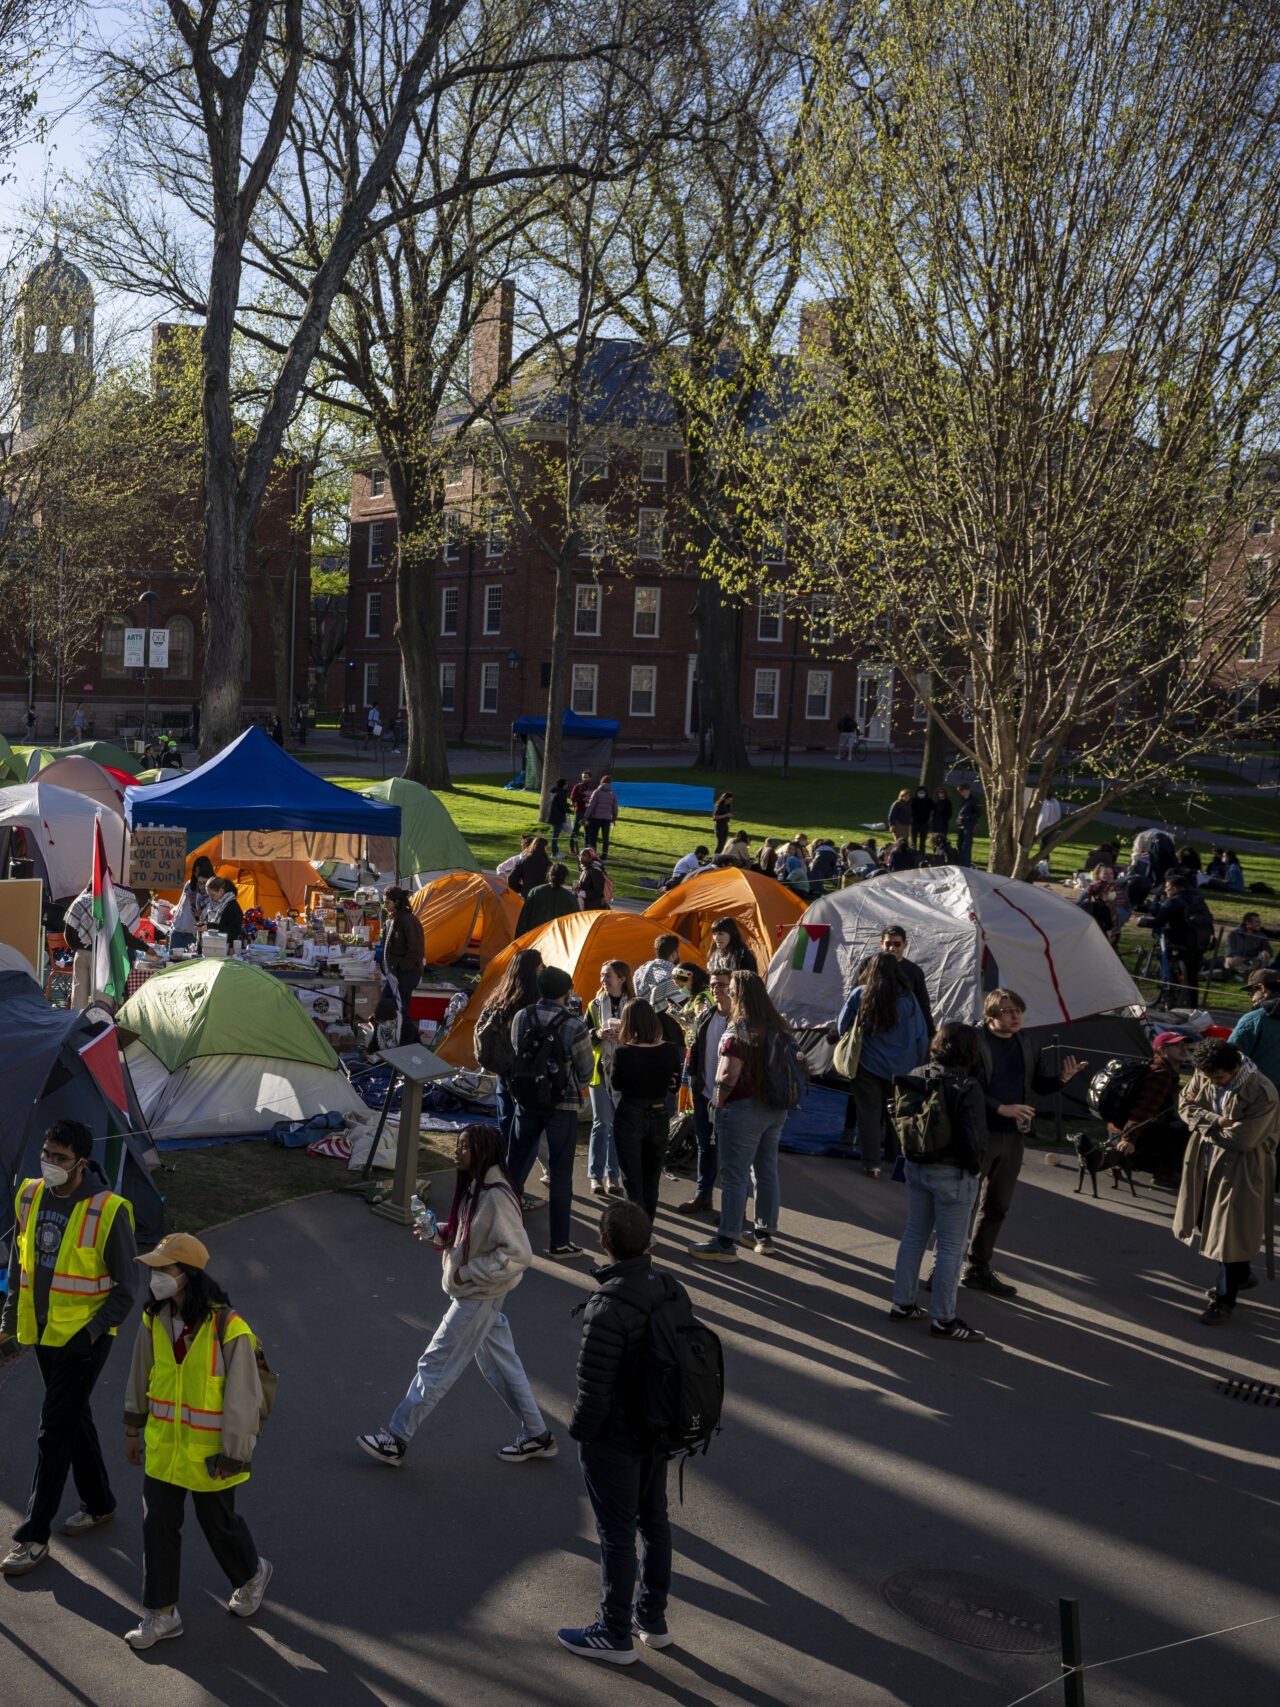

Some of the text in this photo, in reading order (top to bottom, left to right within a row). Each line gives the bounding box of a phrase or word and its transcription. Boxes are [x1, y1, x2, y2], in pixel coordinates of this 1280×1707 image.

[134, 849, 183, 860] COME TALK
[133, 872, 147, 881] TO
